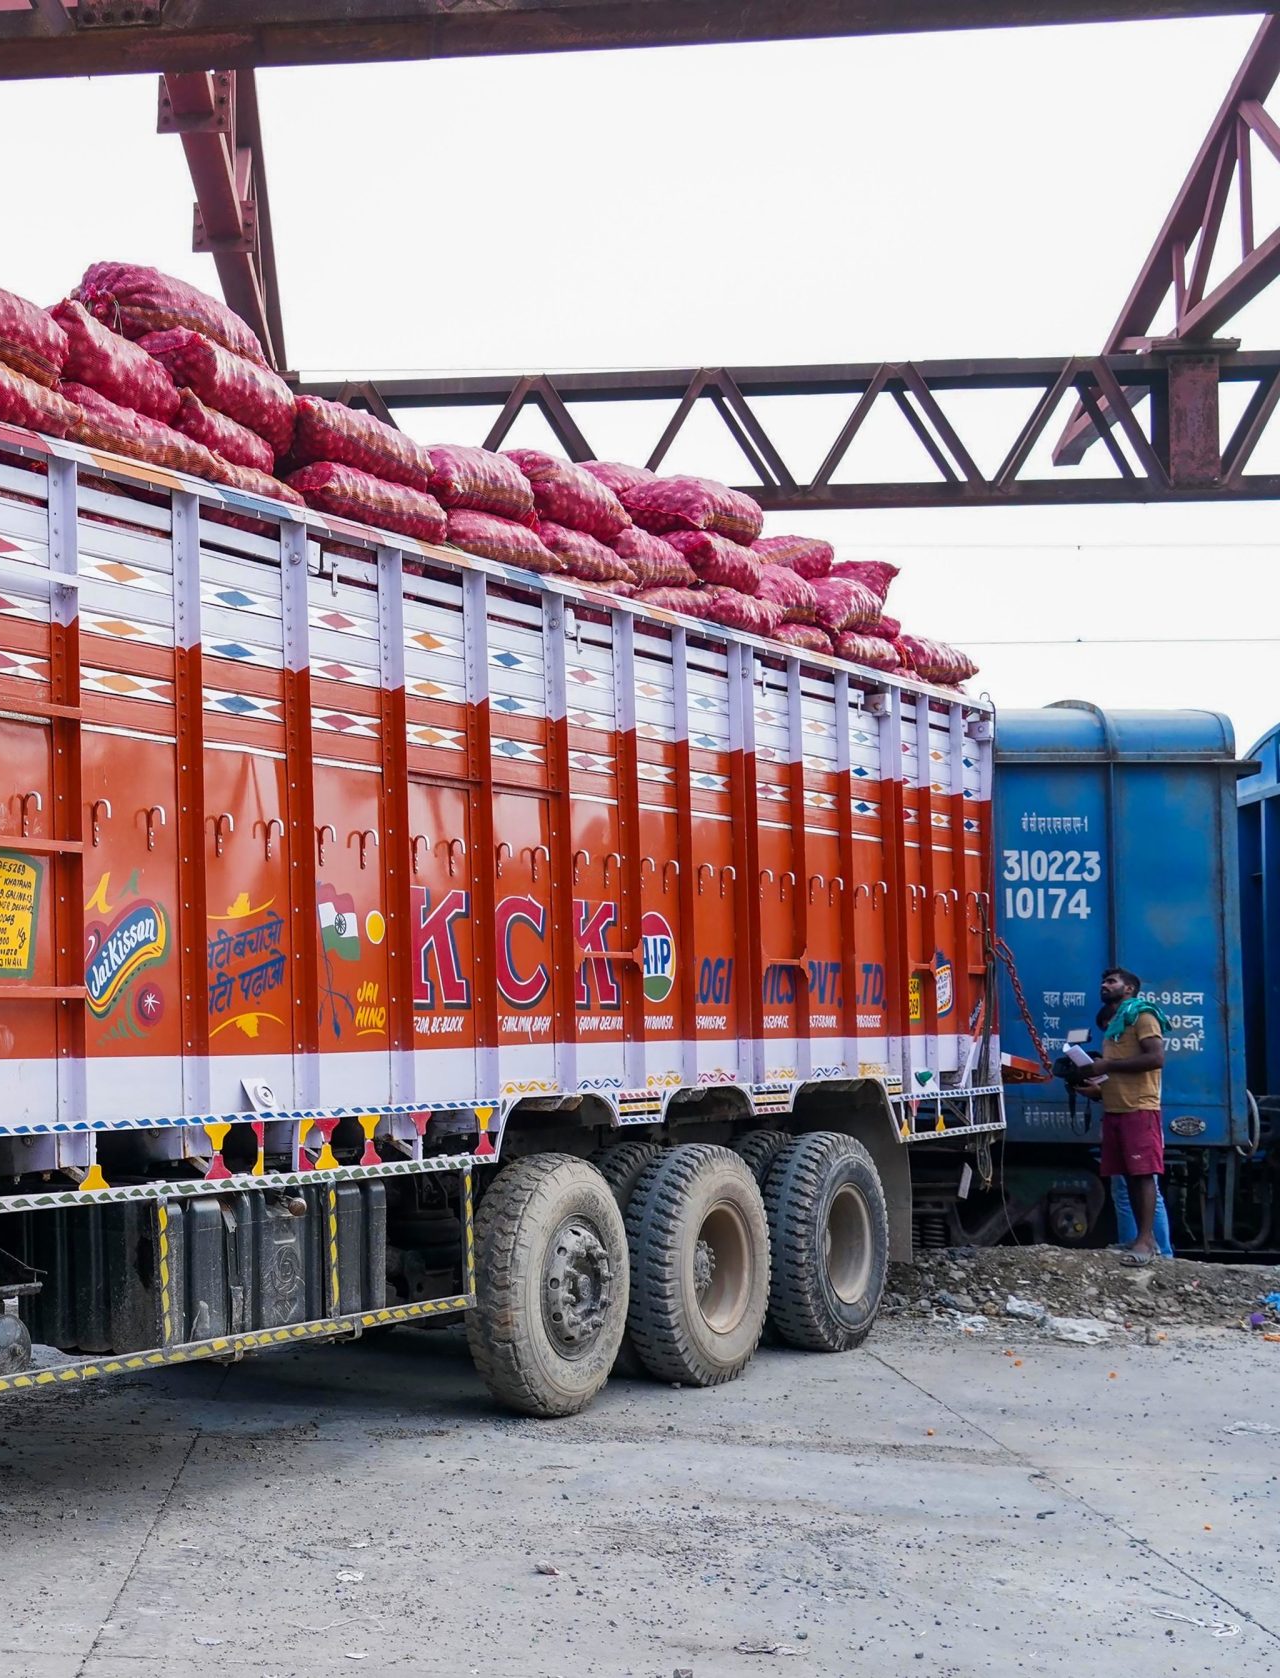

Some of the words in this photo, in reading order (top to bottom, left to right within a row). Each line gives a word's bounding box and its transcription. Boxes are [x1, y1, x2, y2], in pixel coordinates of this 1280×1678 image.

[1003, 850, 1101, 882] 310223
[1005, 887, 1092, 919] 10174
[356, 980, 379, 1005] JAI
[355, 1004, 387, 1029] HIND
